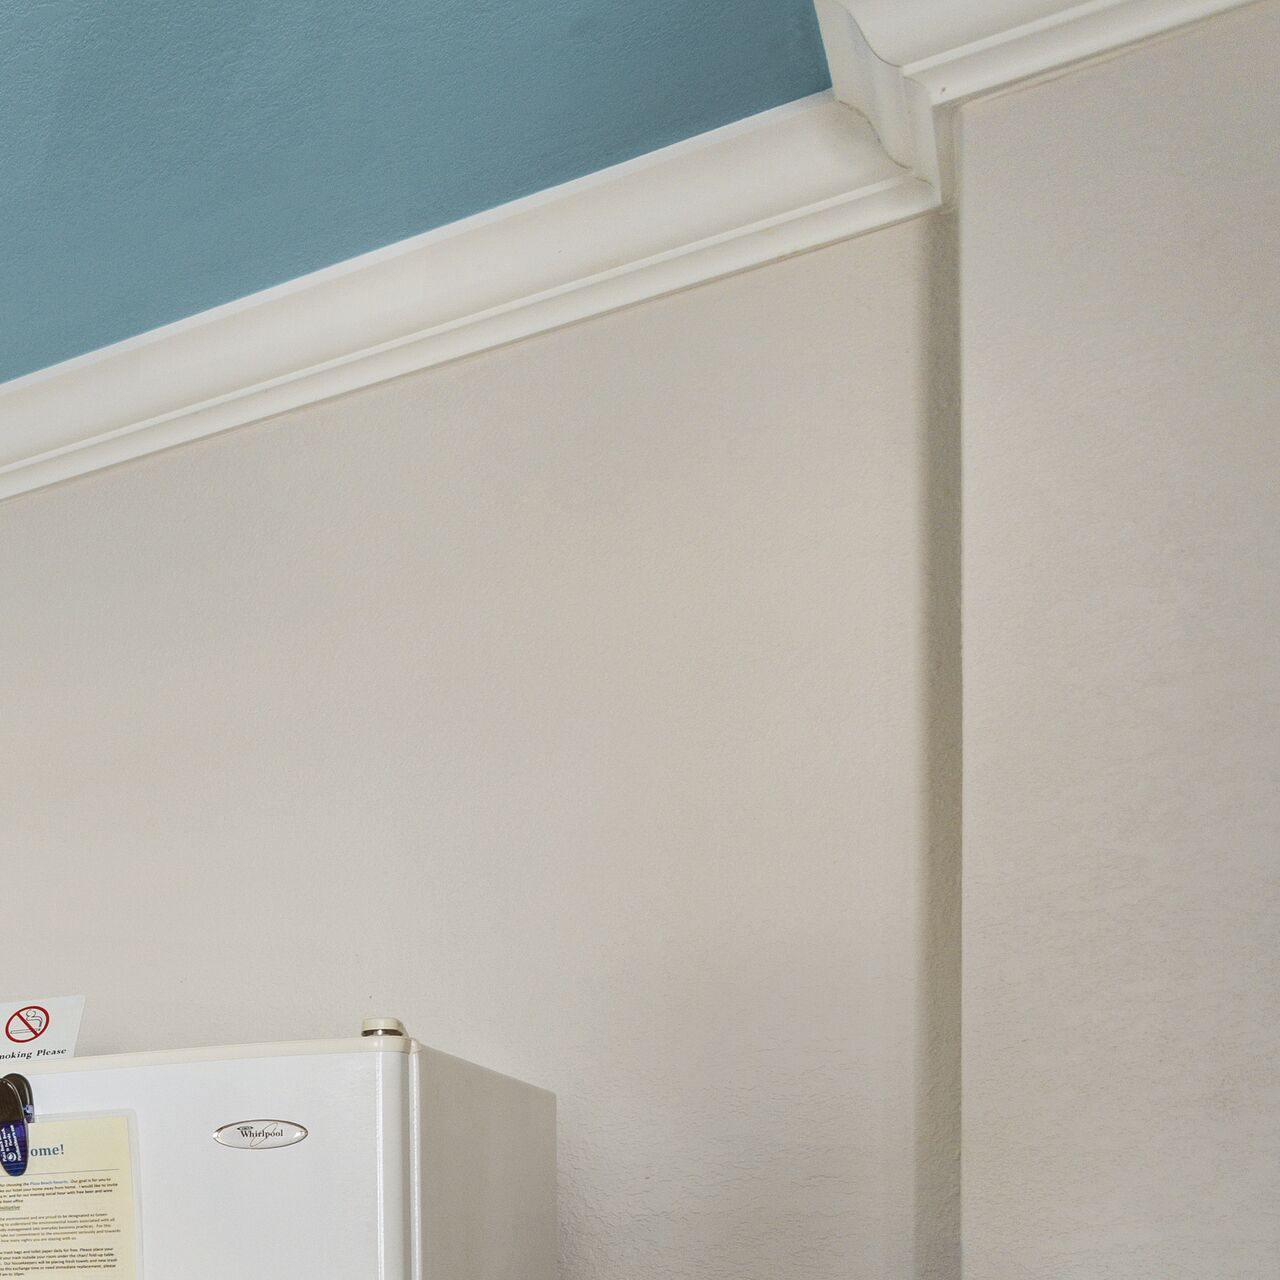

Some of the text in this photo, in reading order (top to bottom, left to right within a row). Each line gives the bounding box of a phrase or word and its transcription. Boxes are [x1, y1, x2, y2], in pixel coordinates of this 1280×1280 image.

[36, 1048, 67, 1056] Please
[240, 1130, 284, 1139] Whirlpool
[30, 1144, 64, 1156] ome!
